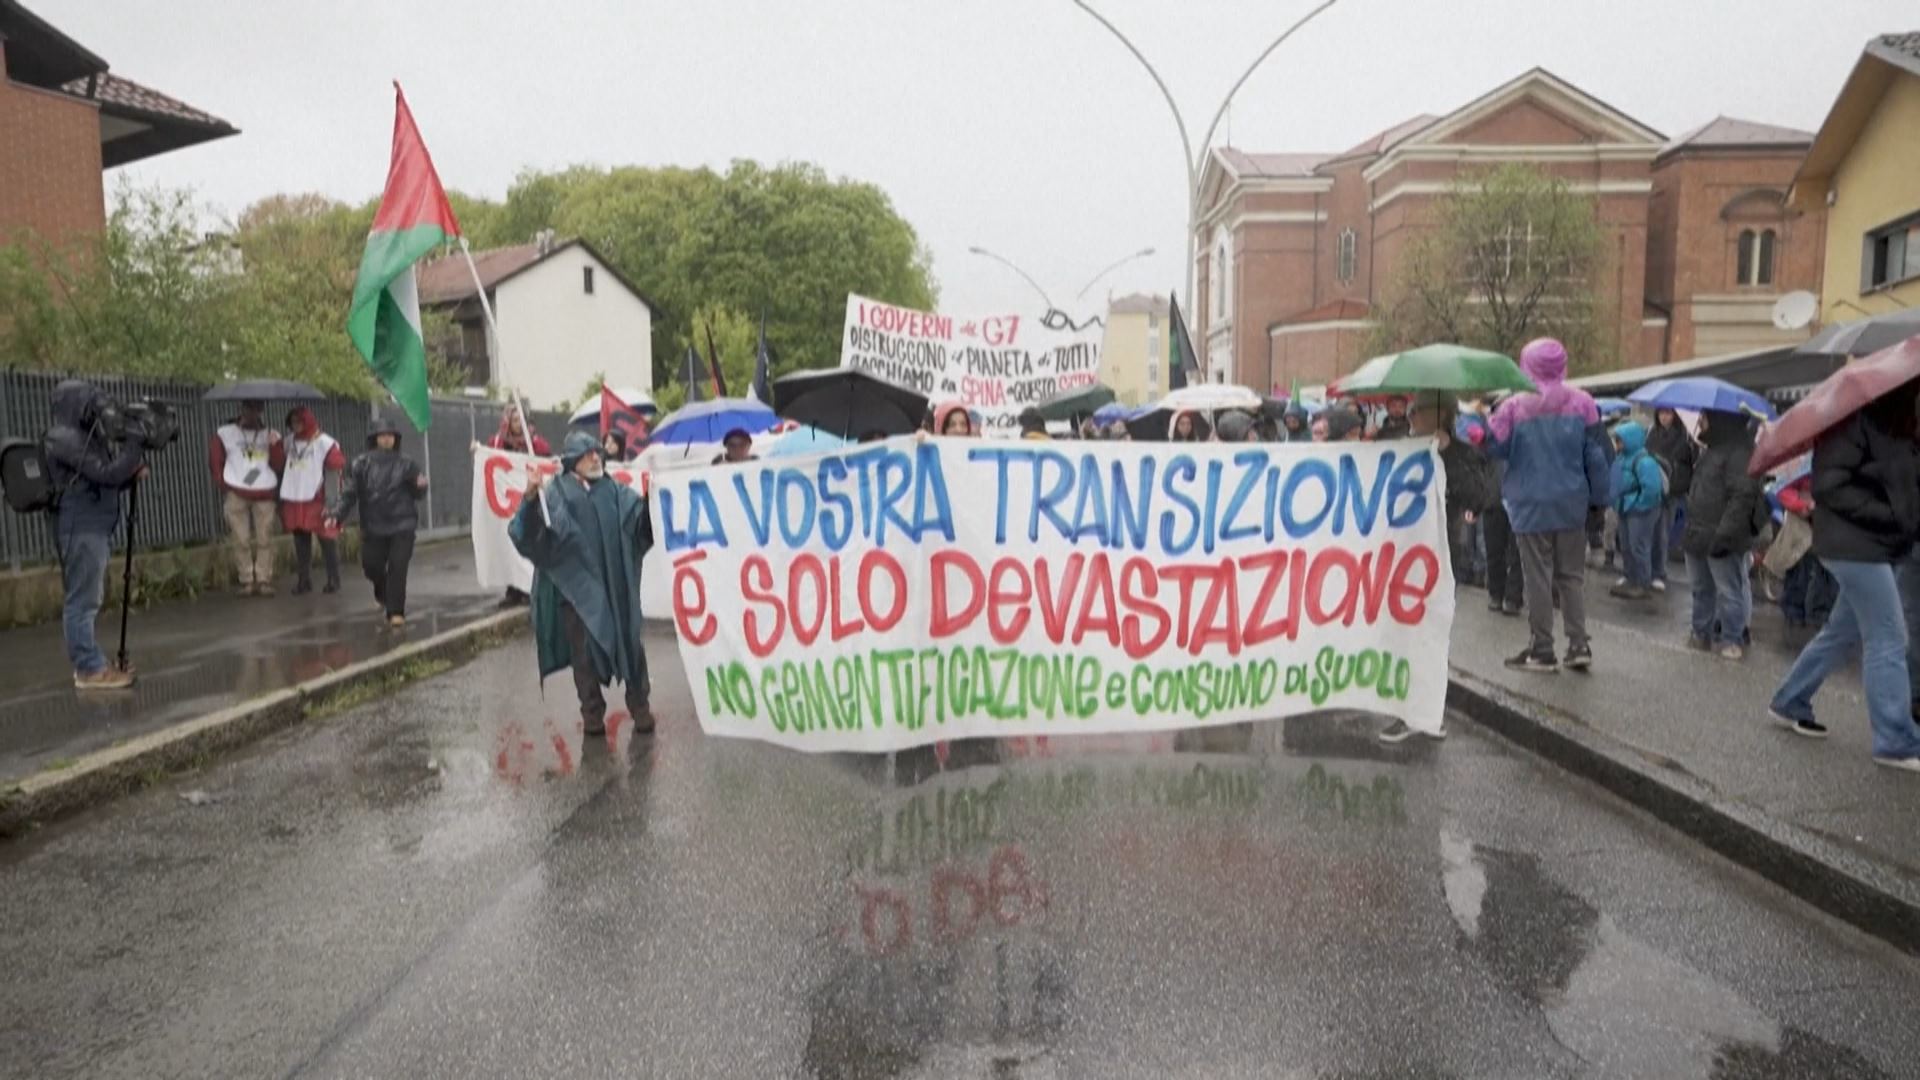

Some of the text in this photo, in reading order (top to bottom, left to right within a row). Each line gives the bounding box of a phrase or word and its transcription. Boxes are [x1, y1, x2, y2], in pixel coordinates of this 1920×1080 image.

[850, 325, 947, 373] DISTRUGGONO
[966, 346, 1033, 378] PIANETA
[859, 303, 865, 325] I
[869, 304, 953, 341] GOVERNI
[982, 315, 1021, 346] G7
[960, 375, 1006, 406] SPINA
[1014, 377, 1057, 403] QUESTO
[659, 480, 728, 551] LA
[732, 443, 955, 551] VOSTRA
[739, 548, 908, 657] SOLO
[706, 661, 757, 719] NO
[1105, 672, 1126, 709] e
[1130, 657, 1278, 718] CONSUMO
[1310, 645, 1410, 706] SUOLO
